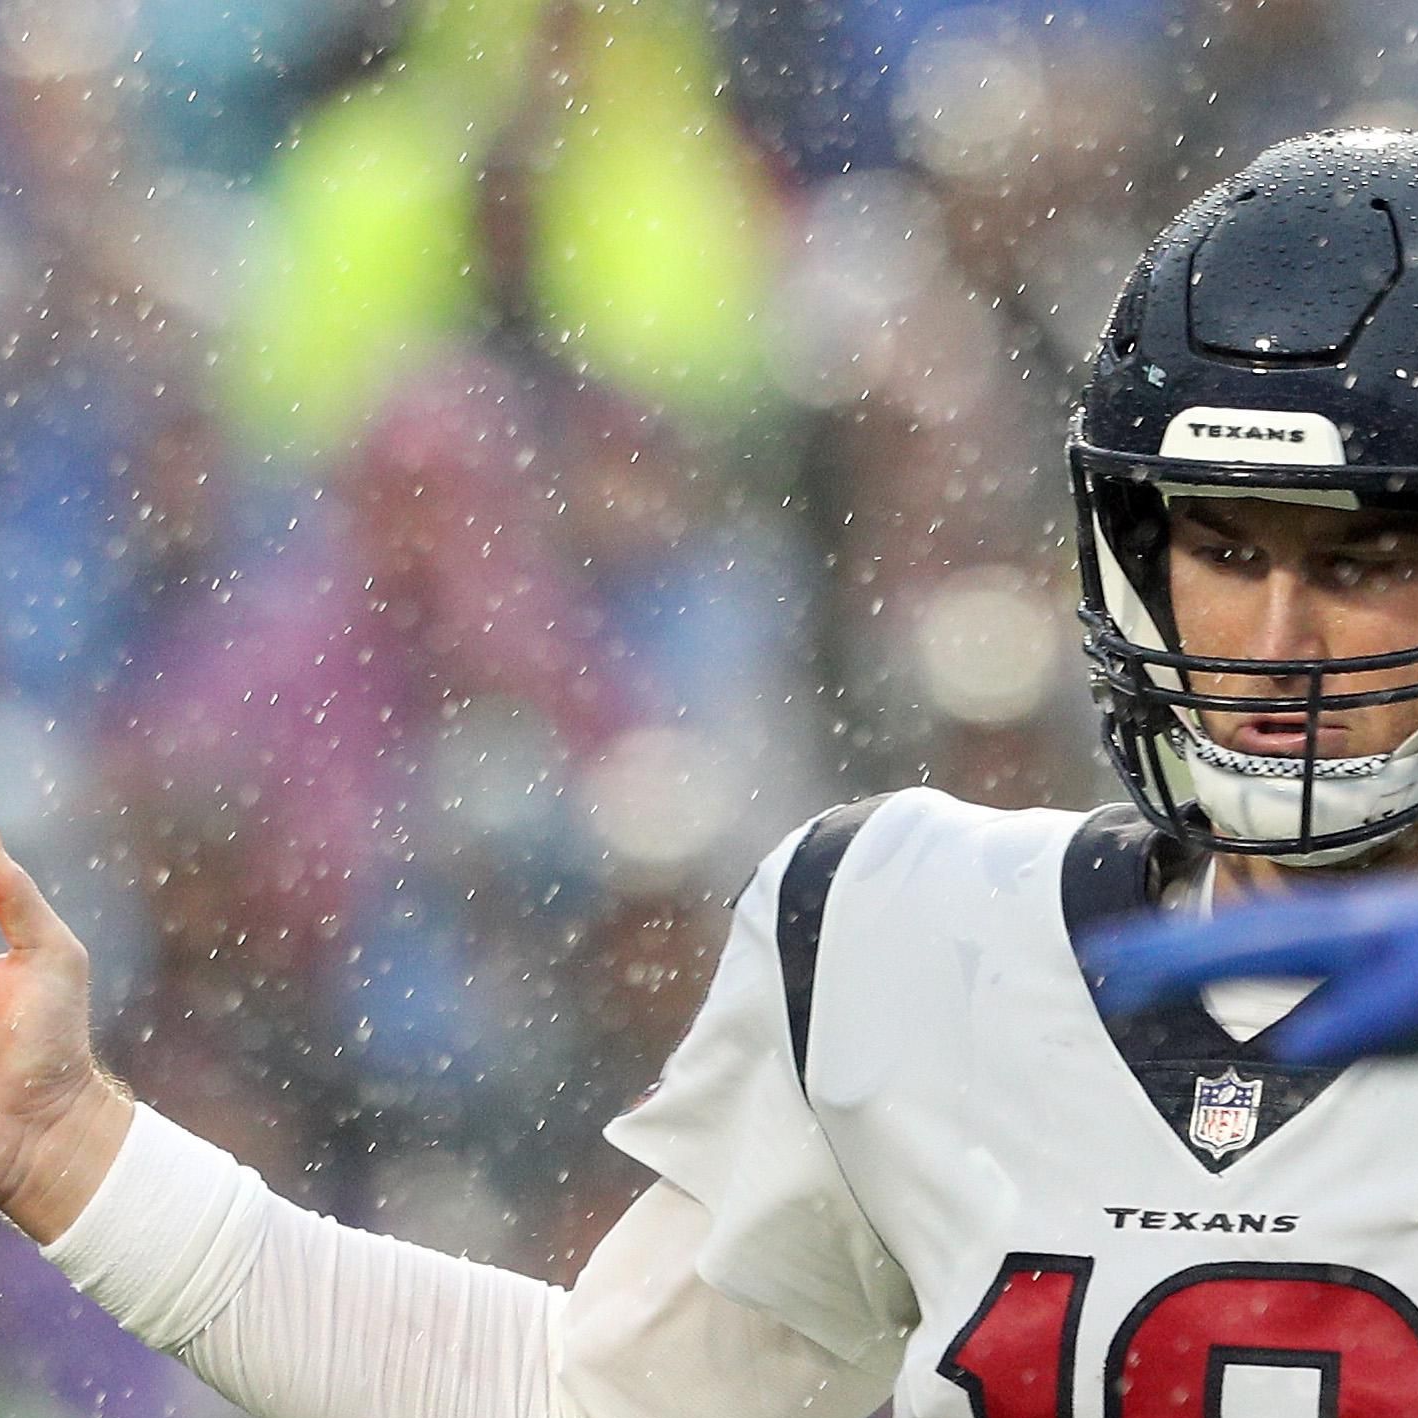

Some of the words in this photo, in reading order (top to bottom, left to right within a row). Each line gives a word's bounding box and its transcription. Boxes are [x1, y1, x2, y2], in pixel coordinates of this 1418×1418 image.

[1187, 422, 1306, 443] TEXANS
[1198, 1108, 1245, 1142] NFL
[1103, 1206, 1301, 1233] TEXANS
